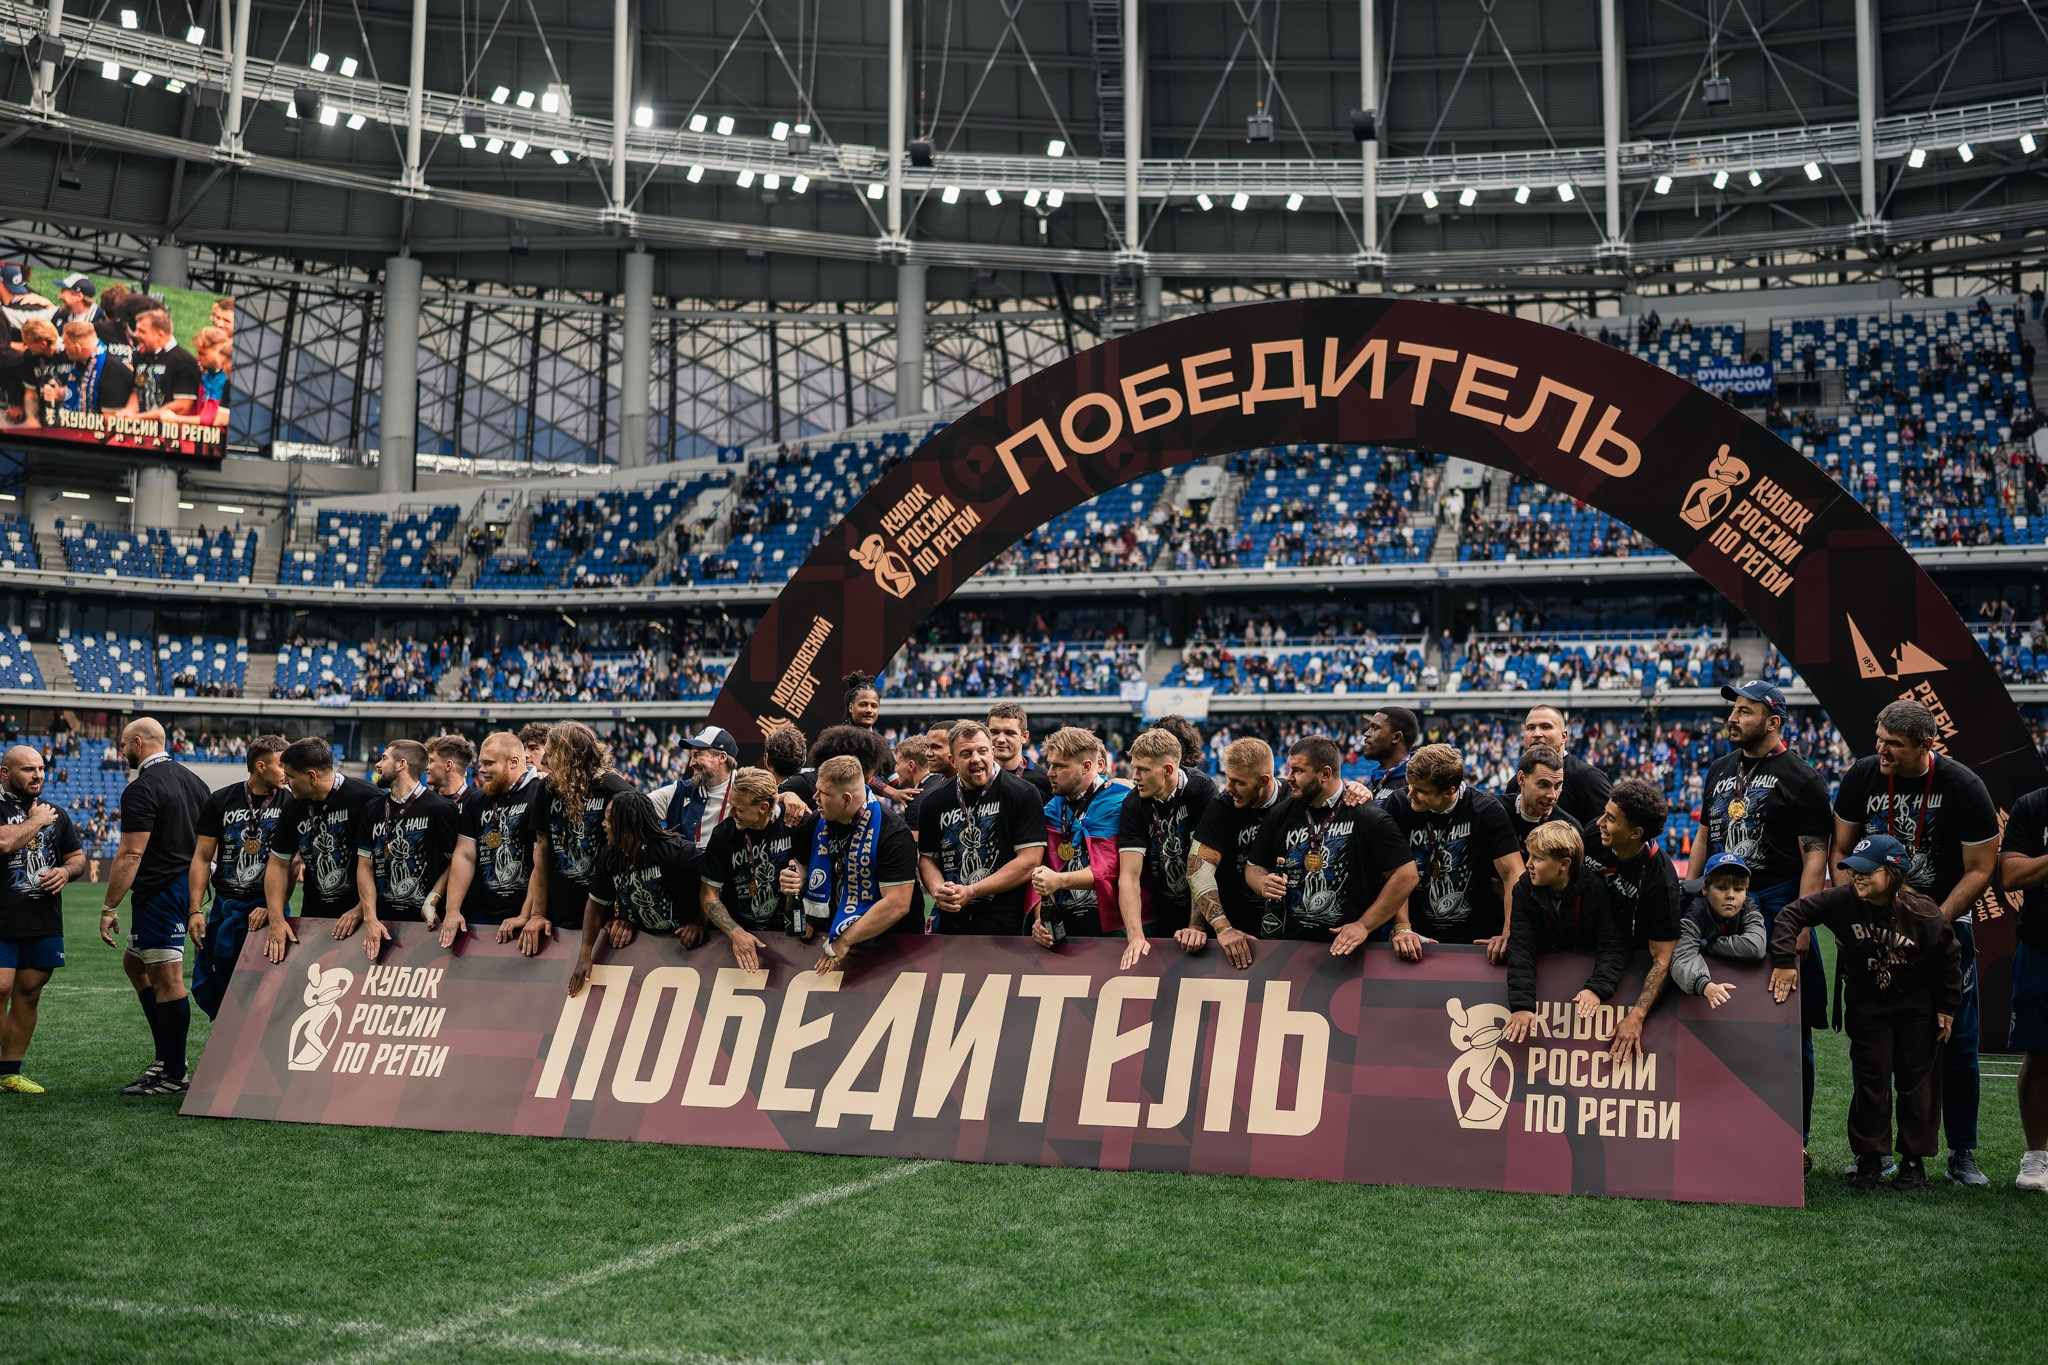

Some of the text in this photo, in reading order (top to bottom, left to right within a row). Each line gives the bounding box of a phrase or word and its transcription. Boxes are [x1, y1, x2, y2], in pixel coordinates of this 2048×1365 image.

[1697, 366, 1765, 381] DYNAMO
[60, 411, 220, 444] КУБОК РОССИИ ПО РЕГБИ
[995, 336, 1643, 496] ПОБЕДИТЕЛЬ
[880, 483, 933, 537] КУБОК
[896, 495, 956, 556] РОССИИ
[1749, 475, 1814, 535] КУБОК
[912, 505, 982, 576] ПО РЕГБИ
[1728, 499, 1804, 566] РОССИИ
[1708, 522, 1794, 598] ПО РЕГБИ
[770, 614, 834, 709] МОСКОВСКИЙ
[1862, 656, 1877, 674] 1892
[785, 671, 821, 719] СПОРТ
[1914, 680, 1958, 739] РЕГБИ
[1751, 775, 1778, 788] НАШ
[1912, 793, 1942, 811] НШ
[327, 808, 349, 826] НАШ
[405, 817, 429, 832] НАШ
[508, 802, 528, 817] НАШ
[977, 801, 1000, 819] НАШ
[1327, 820, 1354, 838] НАШ
[769, 836, 792, 854] НАШ
[1447, 822, 1471, 842] НАШ
[844, 809, 871, 914] ОБЛАДАТЕЛЬ
[860, 828, 874, 900] РОССИИ
[360, 964, 444, 999] КУБОК
[347, 1003, 446, 1038] РОССИИ
[1530, 1001, 1634, 1042] КУБО
[332, 1041, 450, 1078] ПО РЕГБИ
[533, 964, 1331, 1137] ПОБЕДИТЕЛЬ
[1527, 1046, 1657, 1091] РОССИИ
[1524, 1093, 1681, 1140] ПО РЕГБИ
